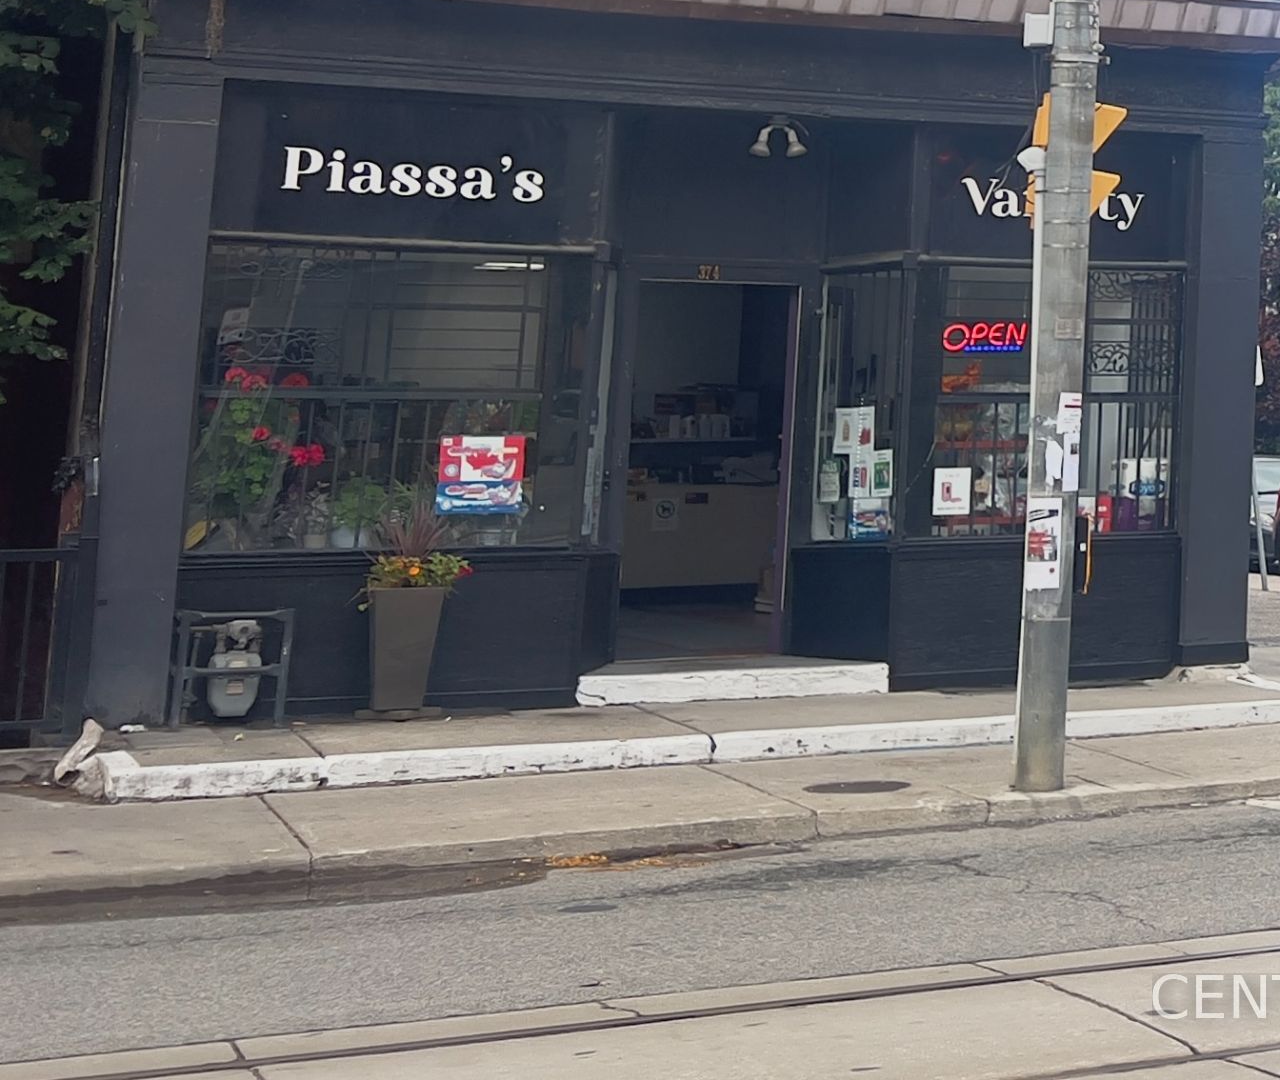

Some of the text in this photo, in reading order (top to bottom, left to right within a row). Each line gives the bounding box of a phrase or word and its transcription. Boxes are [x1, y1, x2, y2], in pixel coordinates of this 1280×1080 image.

[280, 146, 545, 203] Piassa's
[961, 177, 1145, 231] Vaty
[942, 322, 1027, 352] OPEN
